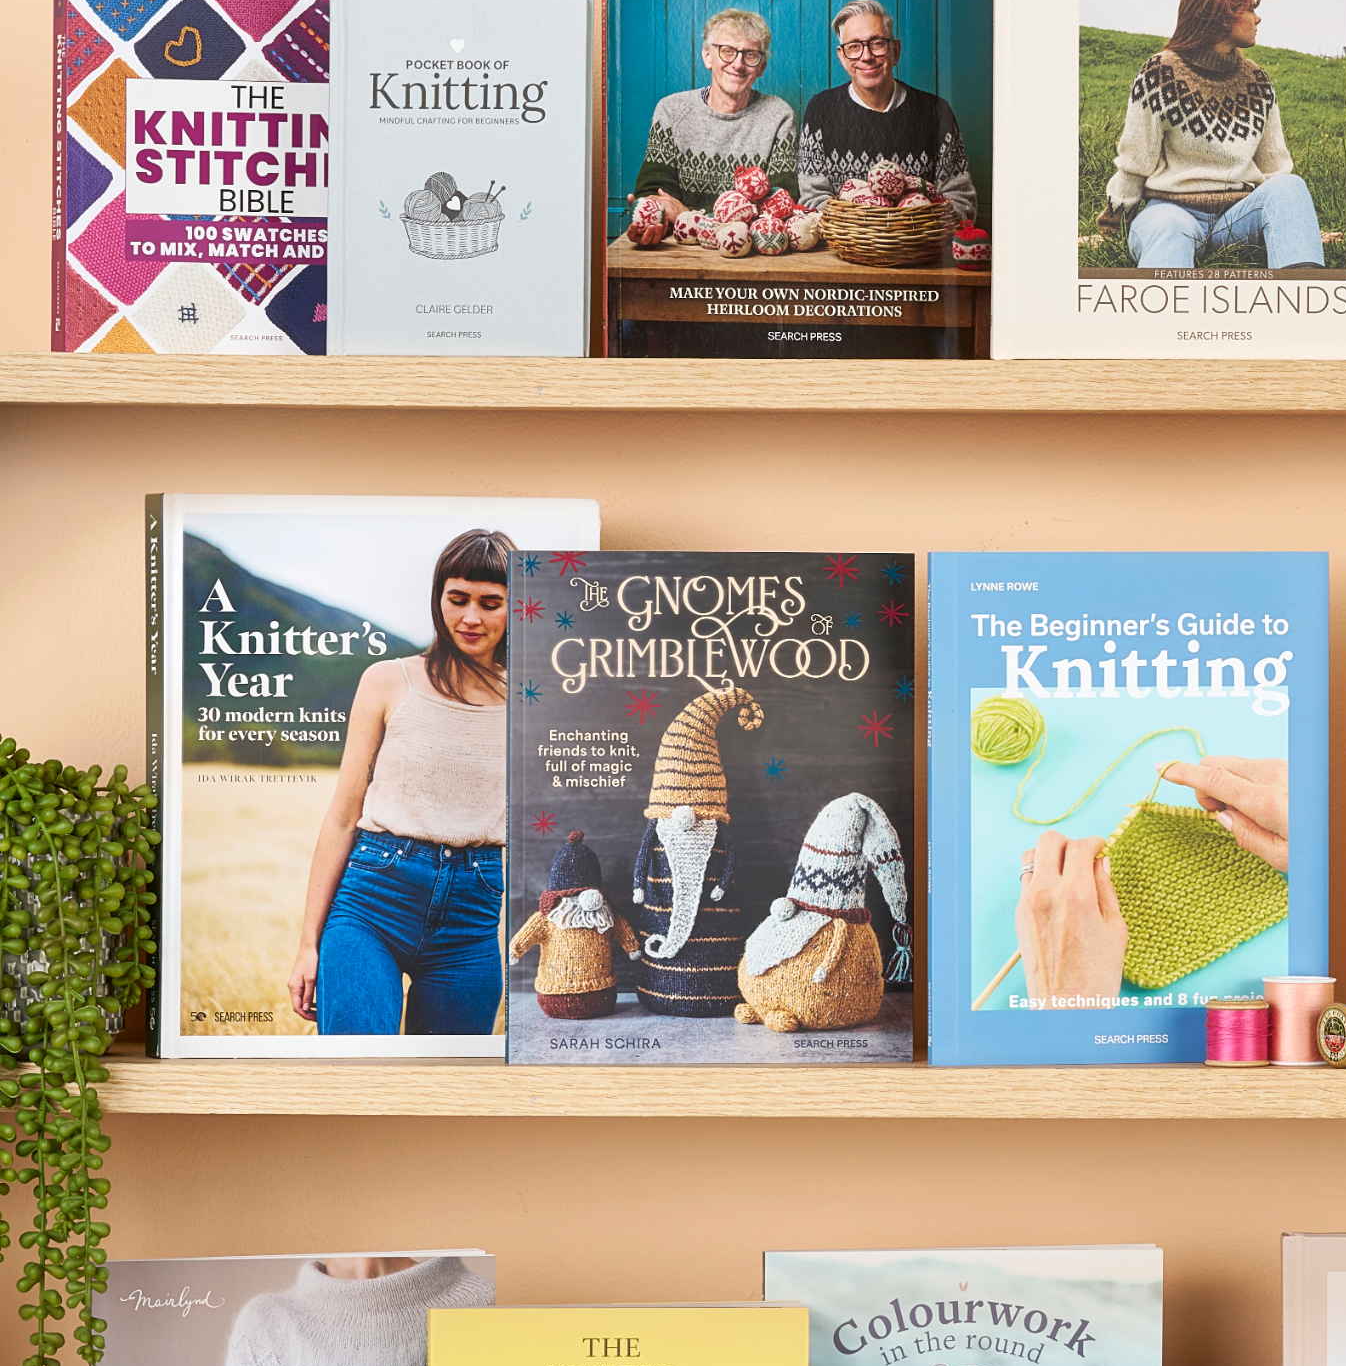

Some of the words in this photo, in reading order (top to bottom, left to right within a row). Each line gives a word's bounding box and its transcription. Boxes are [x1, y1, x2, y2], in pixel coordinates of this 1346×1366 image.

[406, 60, 453, 70] POCKET
[457, 60, 490, 69] BOOK
[494, 60, 510, 69] OF
[231, 86, 285, 109] THE
[370, 73, 548, 123] Knitting
[220, 190, 294, 214] BIBLE
[186, 226, 218, 240] 100
[222, 229, 328, 242] SWATCHES
[130, 242, 160, 256] TO
[161, 243, 203, 258] MIX,
[208, 244, 279, 257] MATCH
[283, 245, 324, 259] AND
[1155, 270, 1204, 279] FEATURES
[1208, 270, 1220, 279] 28
[1224, 270, 1273, 279] PATTERNS
[1077, 285, 1189, 314] FAROE
[416, 305, 450, 314] CLAIRE
[454, 305, 493, 314] GELDER
[707, 303, 790, 317] HEIRLOOM
[794, 304, 902, 319] DECORATIONS
[971, 582, 1004, 591] LYNNE
[1007, 582, 1039, 591] ROWE
[200, 579, 237, 612] A
[971, 614, 1023, 637] The
[1177, 613, 1255, 636] Guide
[1261, 614, 1289, 635] to
[200, 663, 293, 698] Year
[1001, 640, 1293, 716] Knitting
[197, 708, 221, 723] 30
[225, 708, 295, 723] modern
[299, 707, 346, 723] knits
[198, 726, 224, 741] for
[228, 729, 276, 746] every
[280, 728, 340, 742] season
[549, 730, 628, 743] Enchanting
[538, 744, 587, 757] friends
[590, 746, 605, 757] to
[609, 745, 640, 759] knit,
[550, 1038, 599, 1050] SARAH
[605, 1038, 661, 1049] SCHIRA
[582, 1337, 641, 1357] THE
